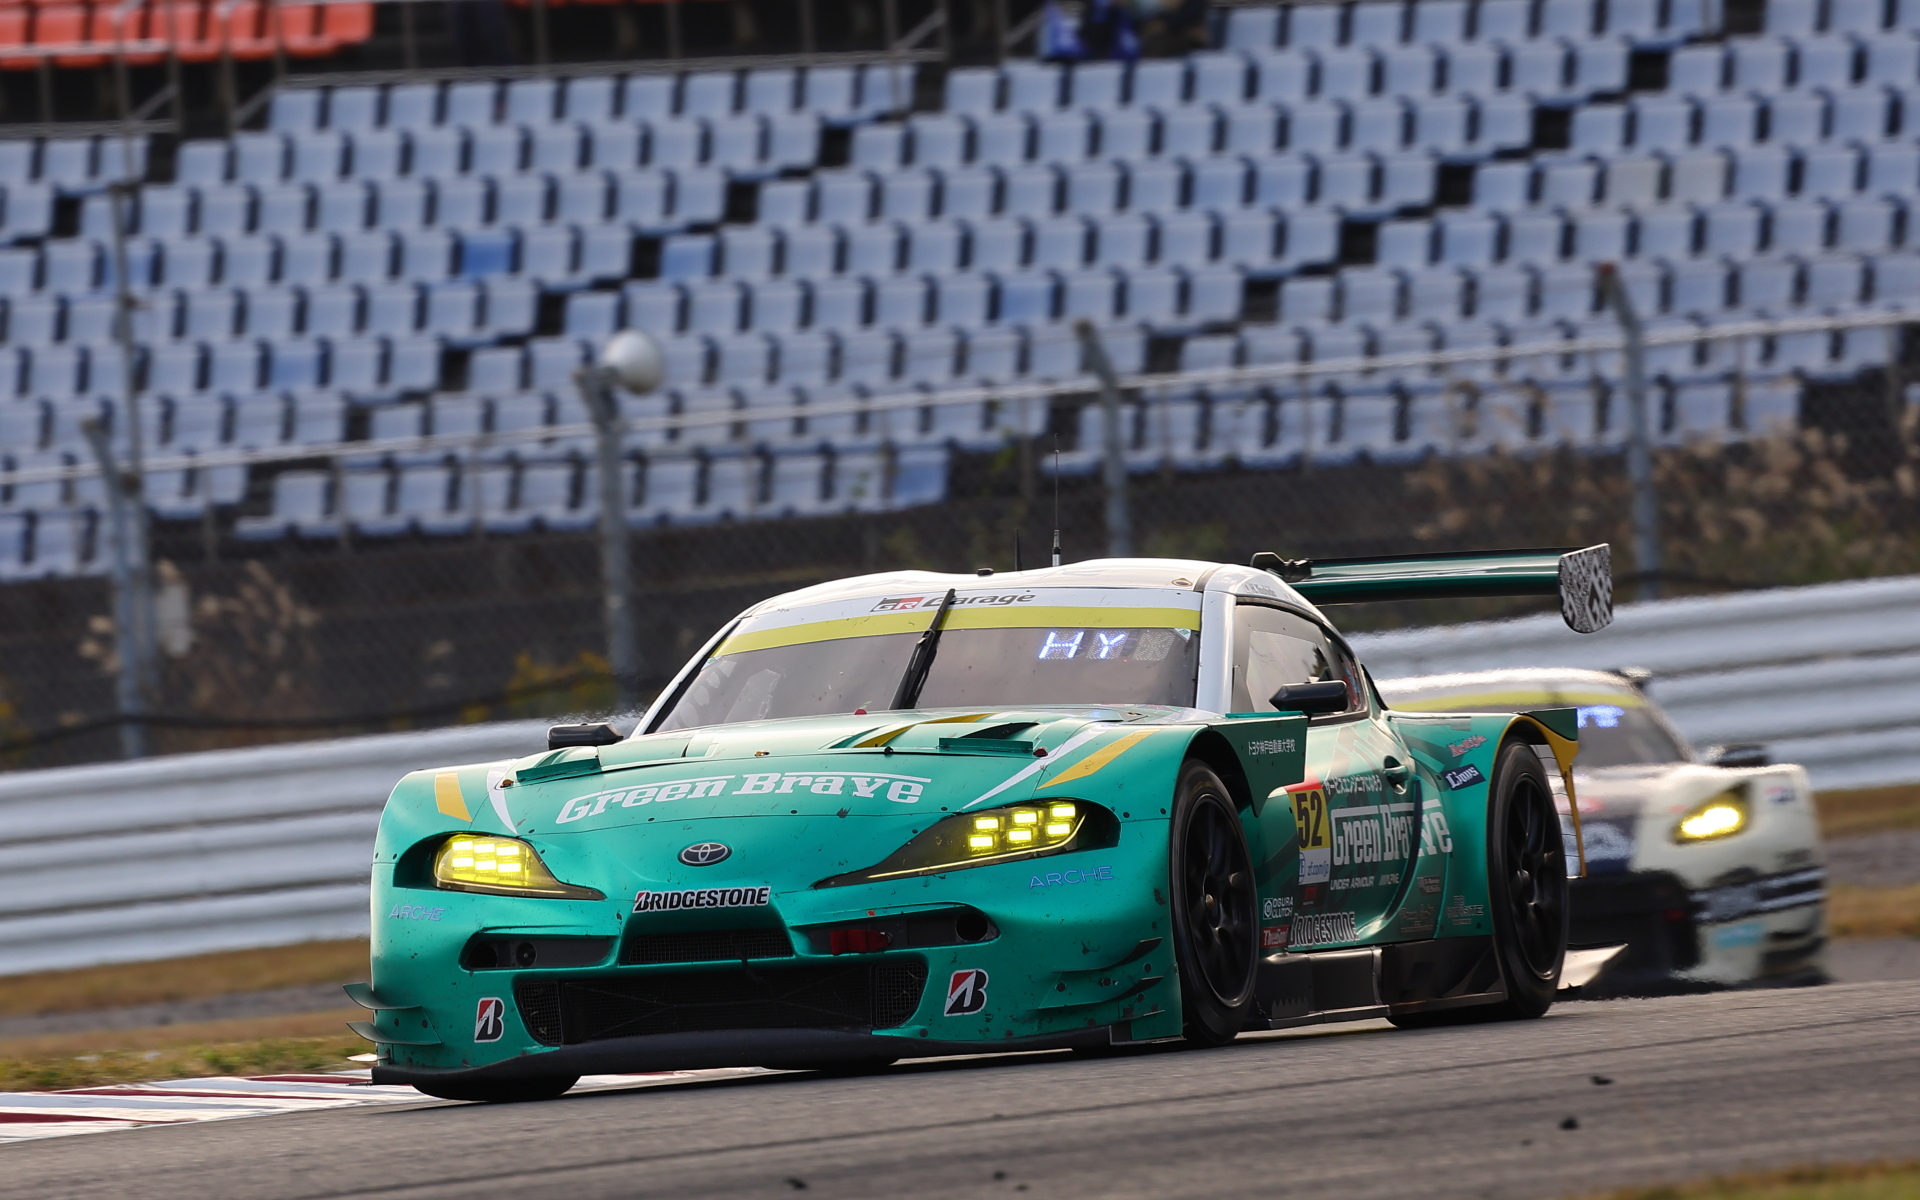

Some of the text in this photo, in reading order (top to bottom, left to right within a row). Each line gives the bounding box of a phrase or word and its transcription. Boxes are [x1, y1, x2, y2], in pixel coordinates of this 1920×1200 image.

[872, 594, 1037, 611] GR Garage
[1038, 630, 1127, 660] HY
[1248, 738, 1296, 755] トヨタ神戸自動車大学校
[1445, 766, 1479, 789] Lions
[555, 771, 932, 824] Green Brave
[1295, 790, 1322, 849] 52
[1330, 799, 1453, 866] Green Brave
[1029, 865, 1115, 889] ARCHE
[1330, 875, 1375, 890] UNDER ARMOUR
[634, 887, 771, 912] BRIDGESTONE
[1272, 896, 1294, 908] OGURA
[389, 903, 446, 921] ARCHE
[1271, 906, 1293, 918] CLUTCH
[1288, 911, 1360, 947] BRIDGESTONE
